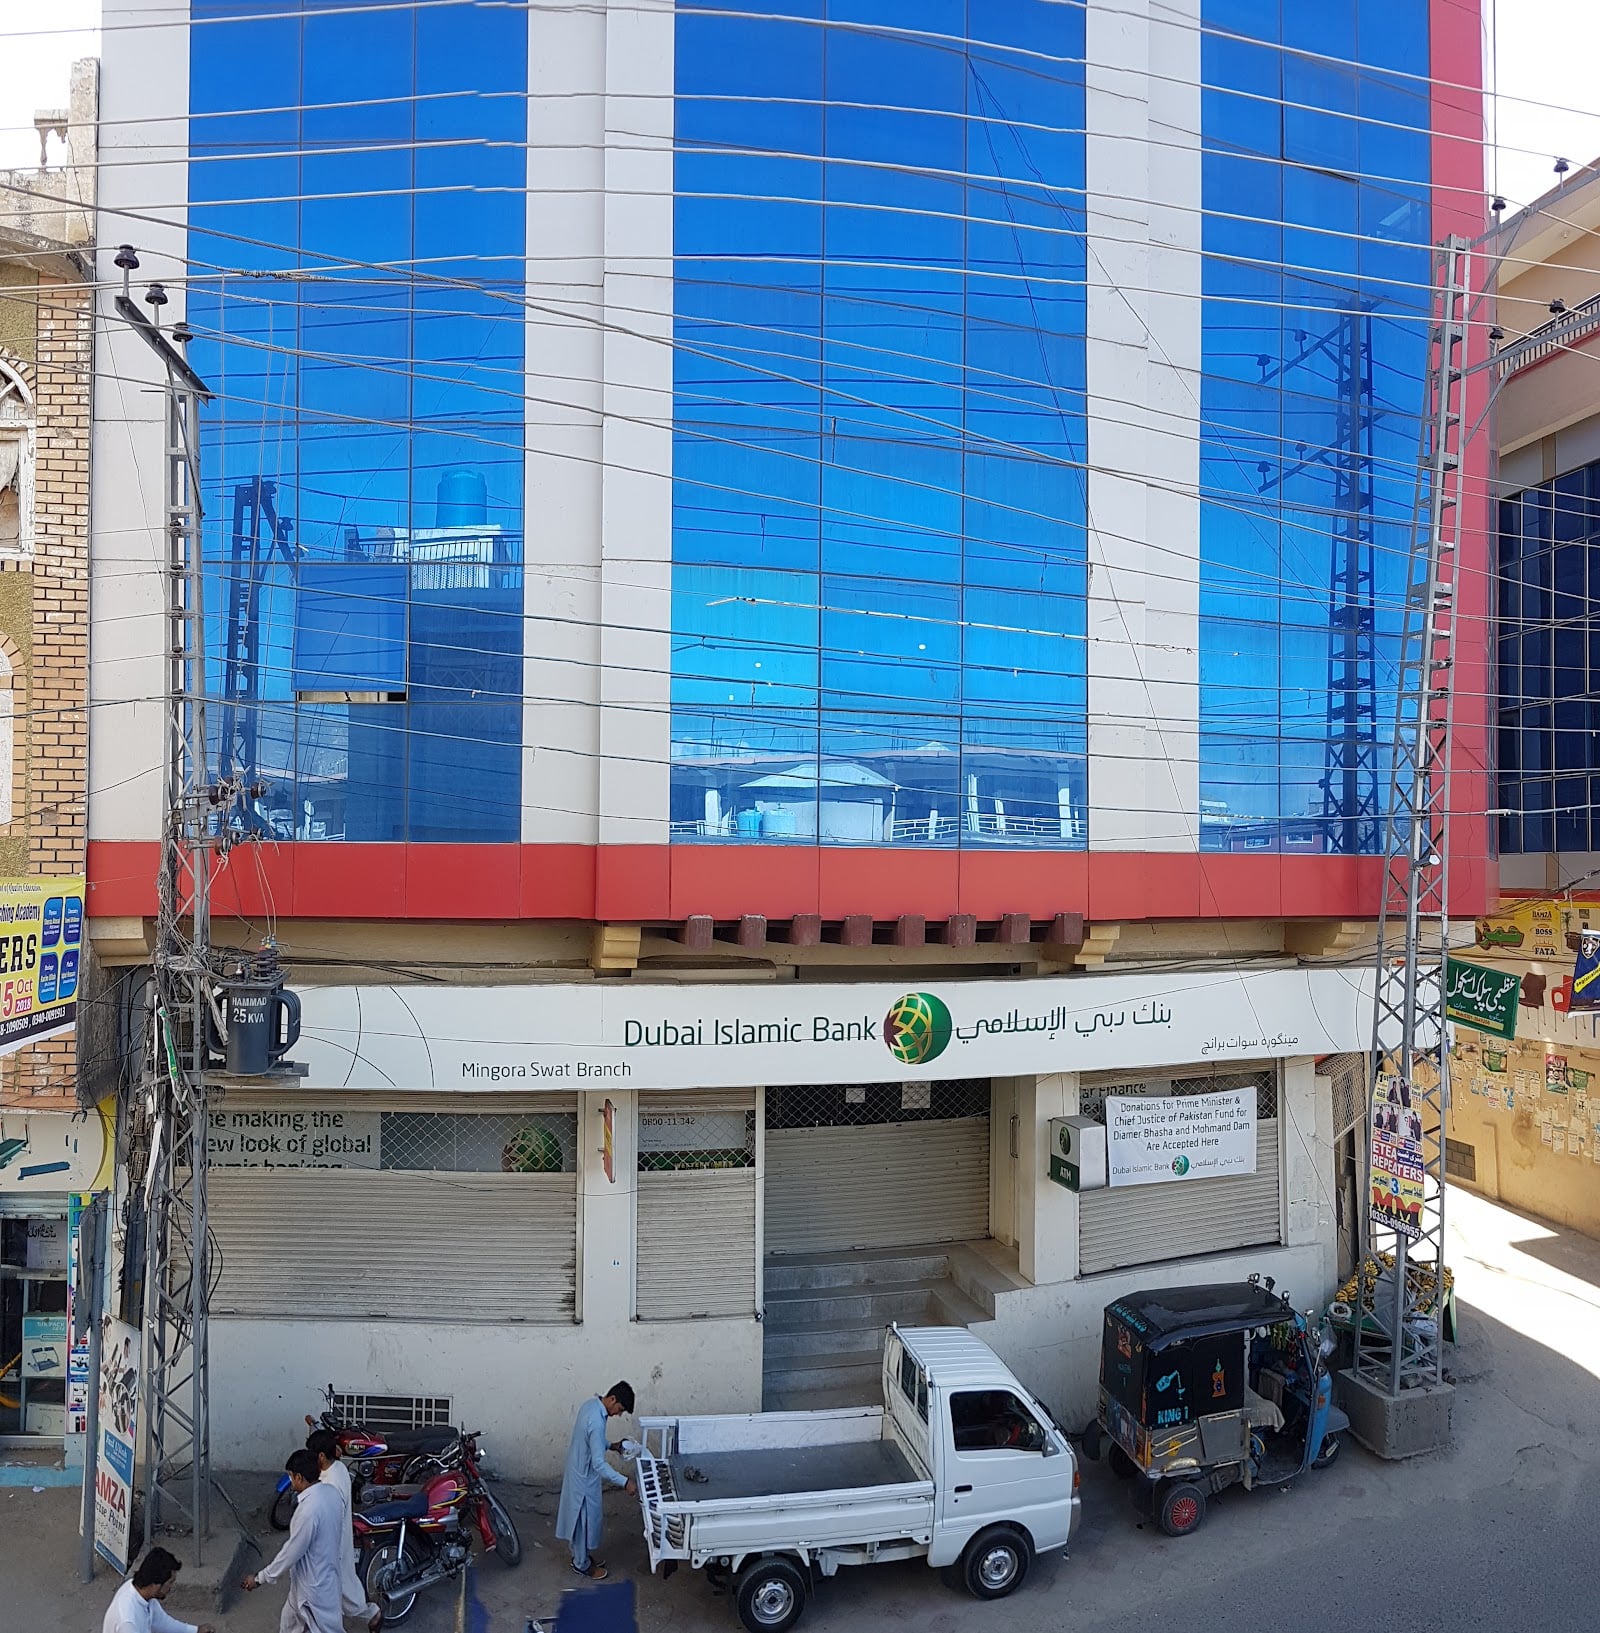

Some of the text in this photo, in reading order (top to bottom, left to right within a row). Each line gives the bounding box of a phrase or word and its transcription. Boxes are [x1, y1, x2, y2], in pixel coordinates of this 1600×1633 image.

[15, 903, 40, 921] Academy
[1534, 947, 1556, 956] FATA
[17, 977, 33, 994] Oct
[15, 998, 31, 1012] 2018
[232, 996, 267, 1007] HAMMAD
[233, 1007, 265, 1023] 25 KVA
[956, 1000, 1172, 1044] بنك دبي الإسلامي
[625, 1015, 877, 1046] Dubai Islamic Bank
[462, 1061, 632, 1081] Mingora Swat Branch
[1120, 1100, 1161, 1113] Donations
[1163, 1099, 1174, 1110] for
[1176, 1098, 1200, 1109] Prime
[1201, 1096, 1233, 1107] Minister
[311, 1111, 344, 1128] the
[1114, 1107, 1248, 1127] Chief Justice of Pakistan Fund for
[1113, 1120, 1250, 1141] Diamer Bhasha and Mohmand Dam
[240, 1134, 281, 1153] look
[287, 1134, 307, 1153] of
[312, 1134, 371, 1157] global
[1146, 1137, 1219, 1151] Are Accepted Here
[1373, 1141, 1397, 1161] ETEA
[1112, 1160, 1170, 1175] Dubai Islamic Bank
[1373, 1154, 1423, 1183] REPEATERS
[1391, 1177, 1399, 1194] 3
[1157, 1408, 1182, 1424] KING
